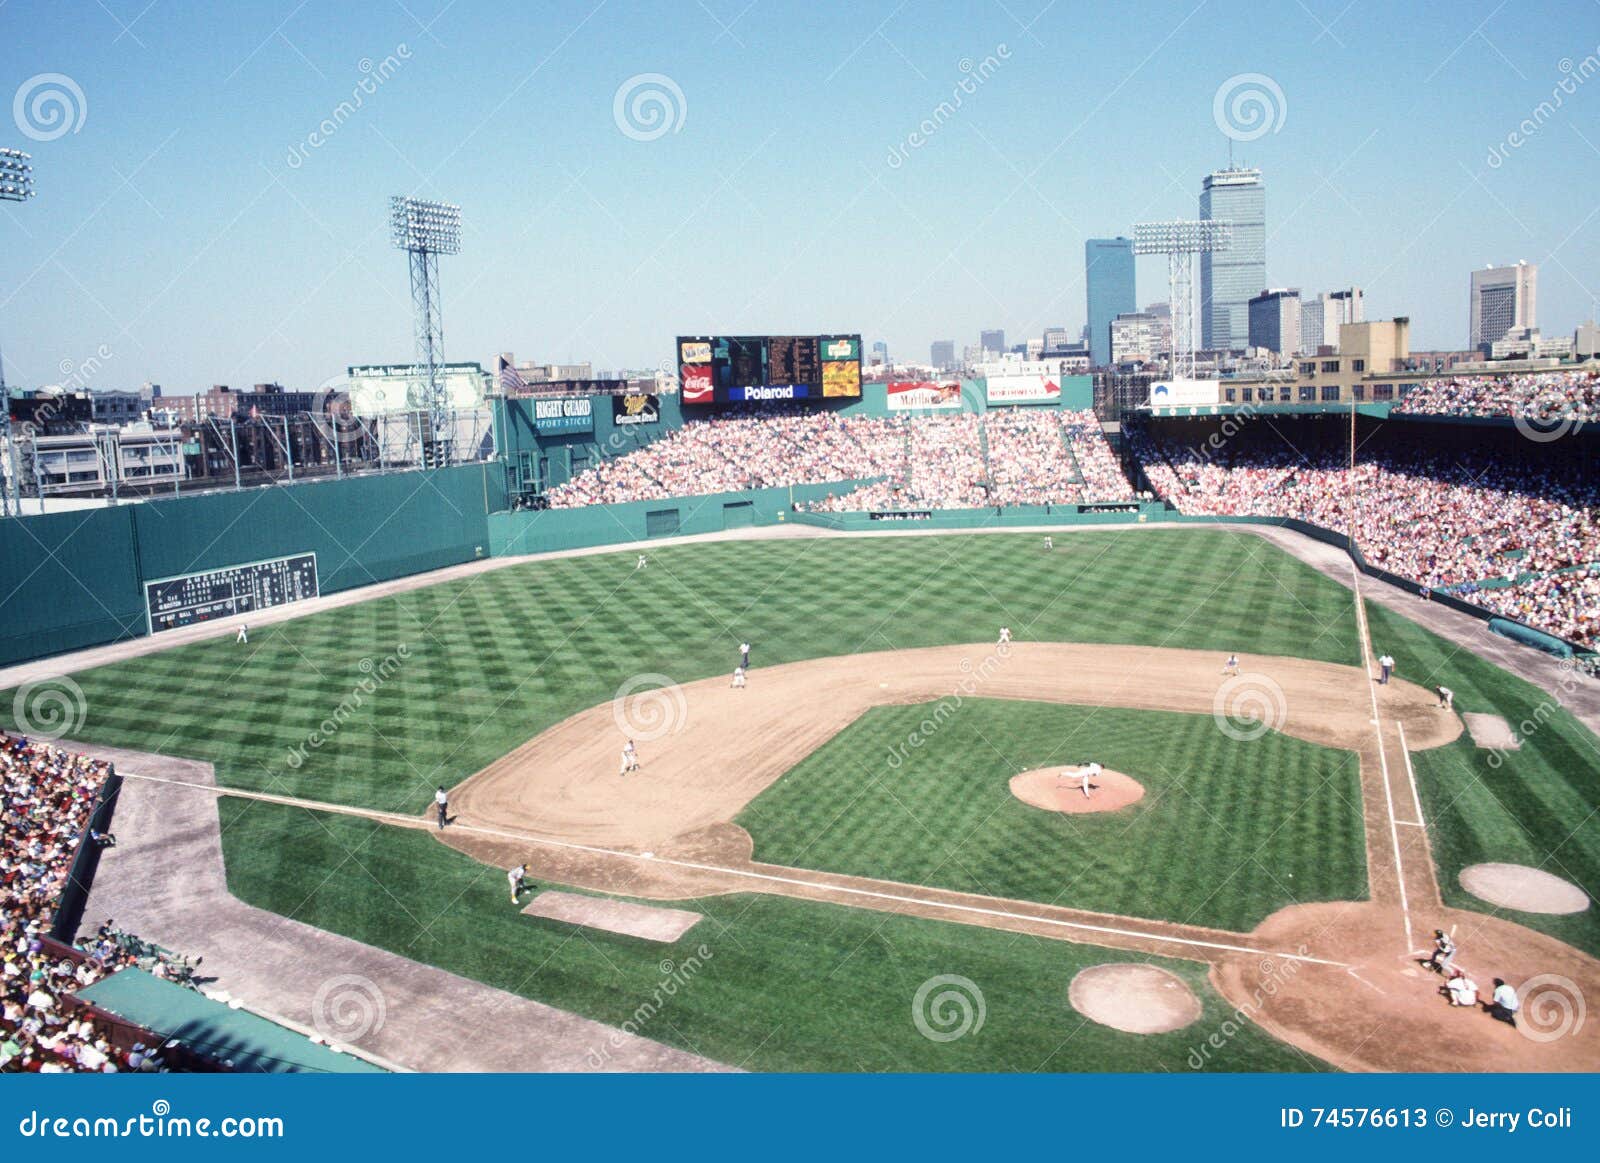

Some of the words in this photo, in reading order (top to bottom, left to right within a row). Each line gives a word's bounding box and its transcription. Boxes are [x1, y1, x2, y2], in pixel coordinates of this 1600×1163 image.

[744, 385, 793, 400] Polaroid
[536, 400, 562, 418] RIGHT
[564, 399, 590, 416] GUARD
[536, 419, 561, 428] SPORT
[186, 570, 240, 584] AMERICAN
[252, 561, 288, 572] LEAGUE
